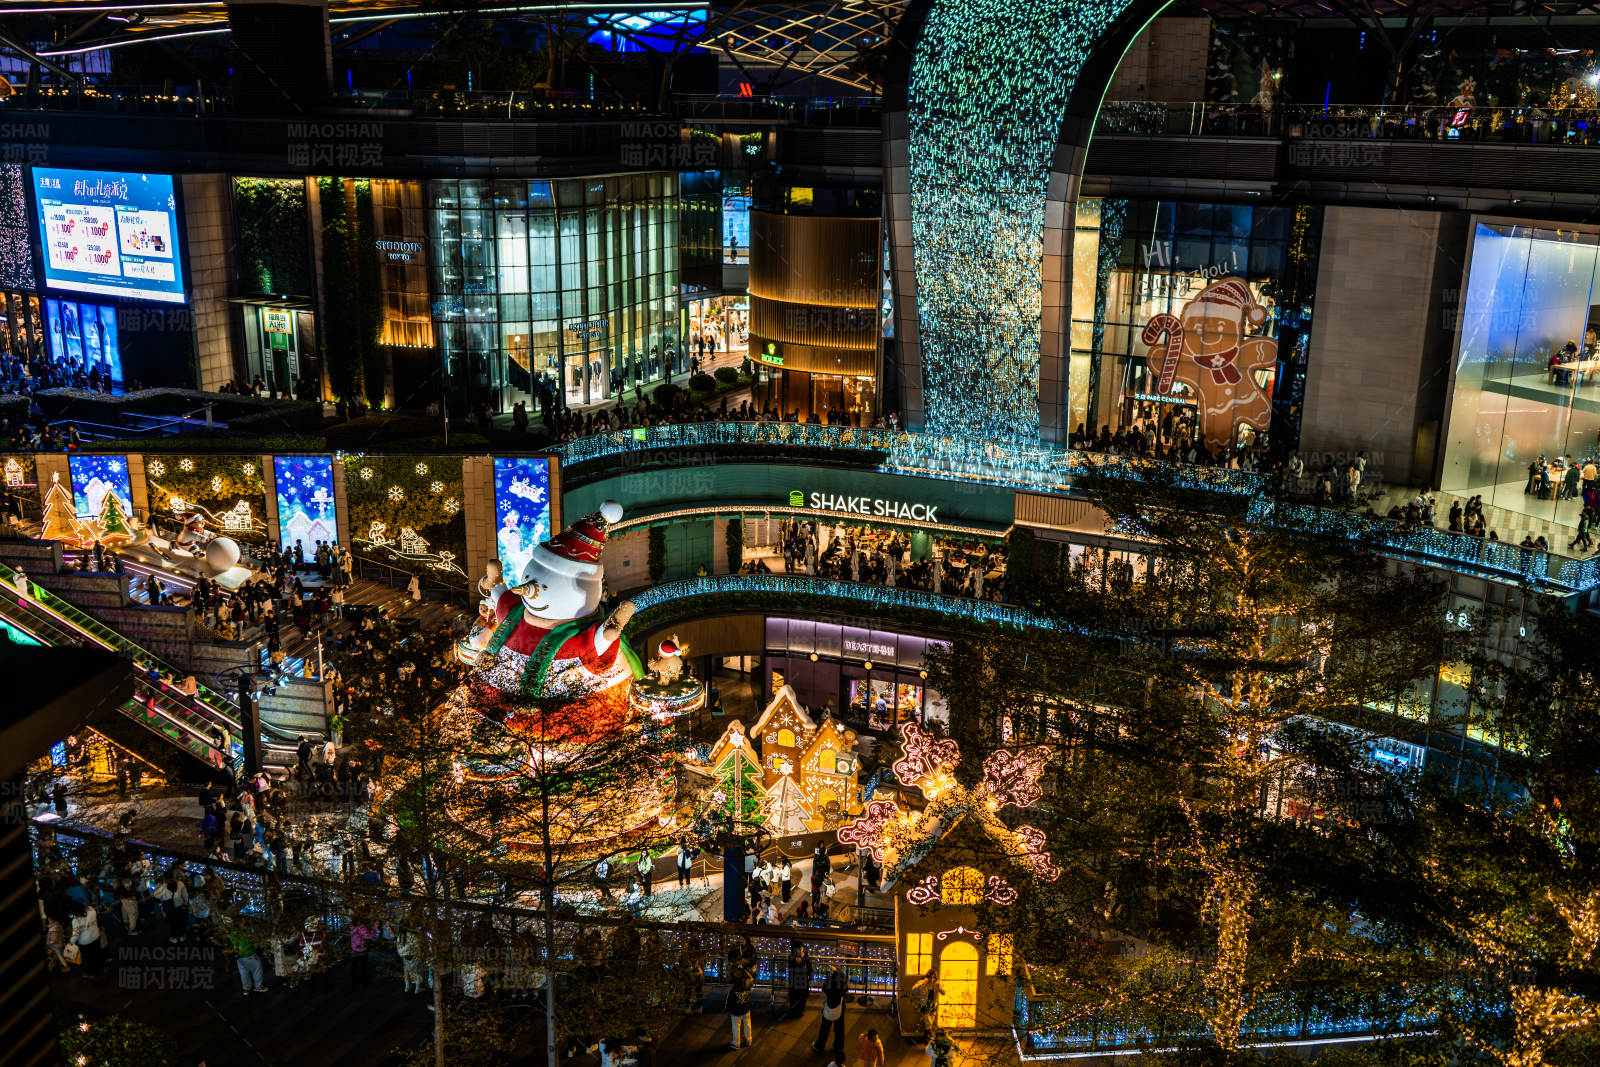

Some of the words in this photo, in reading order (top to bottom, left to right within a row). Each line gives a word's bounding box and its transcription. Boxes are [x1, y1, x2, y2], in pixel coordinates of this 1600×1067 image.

[761, 353, 784, 365] ROLEX
[810, 492, 871, 515] SHAKE
[873, 499, 938, 523] SHACK
